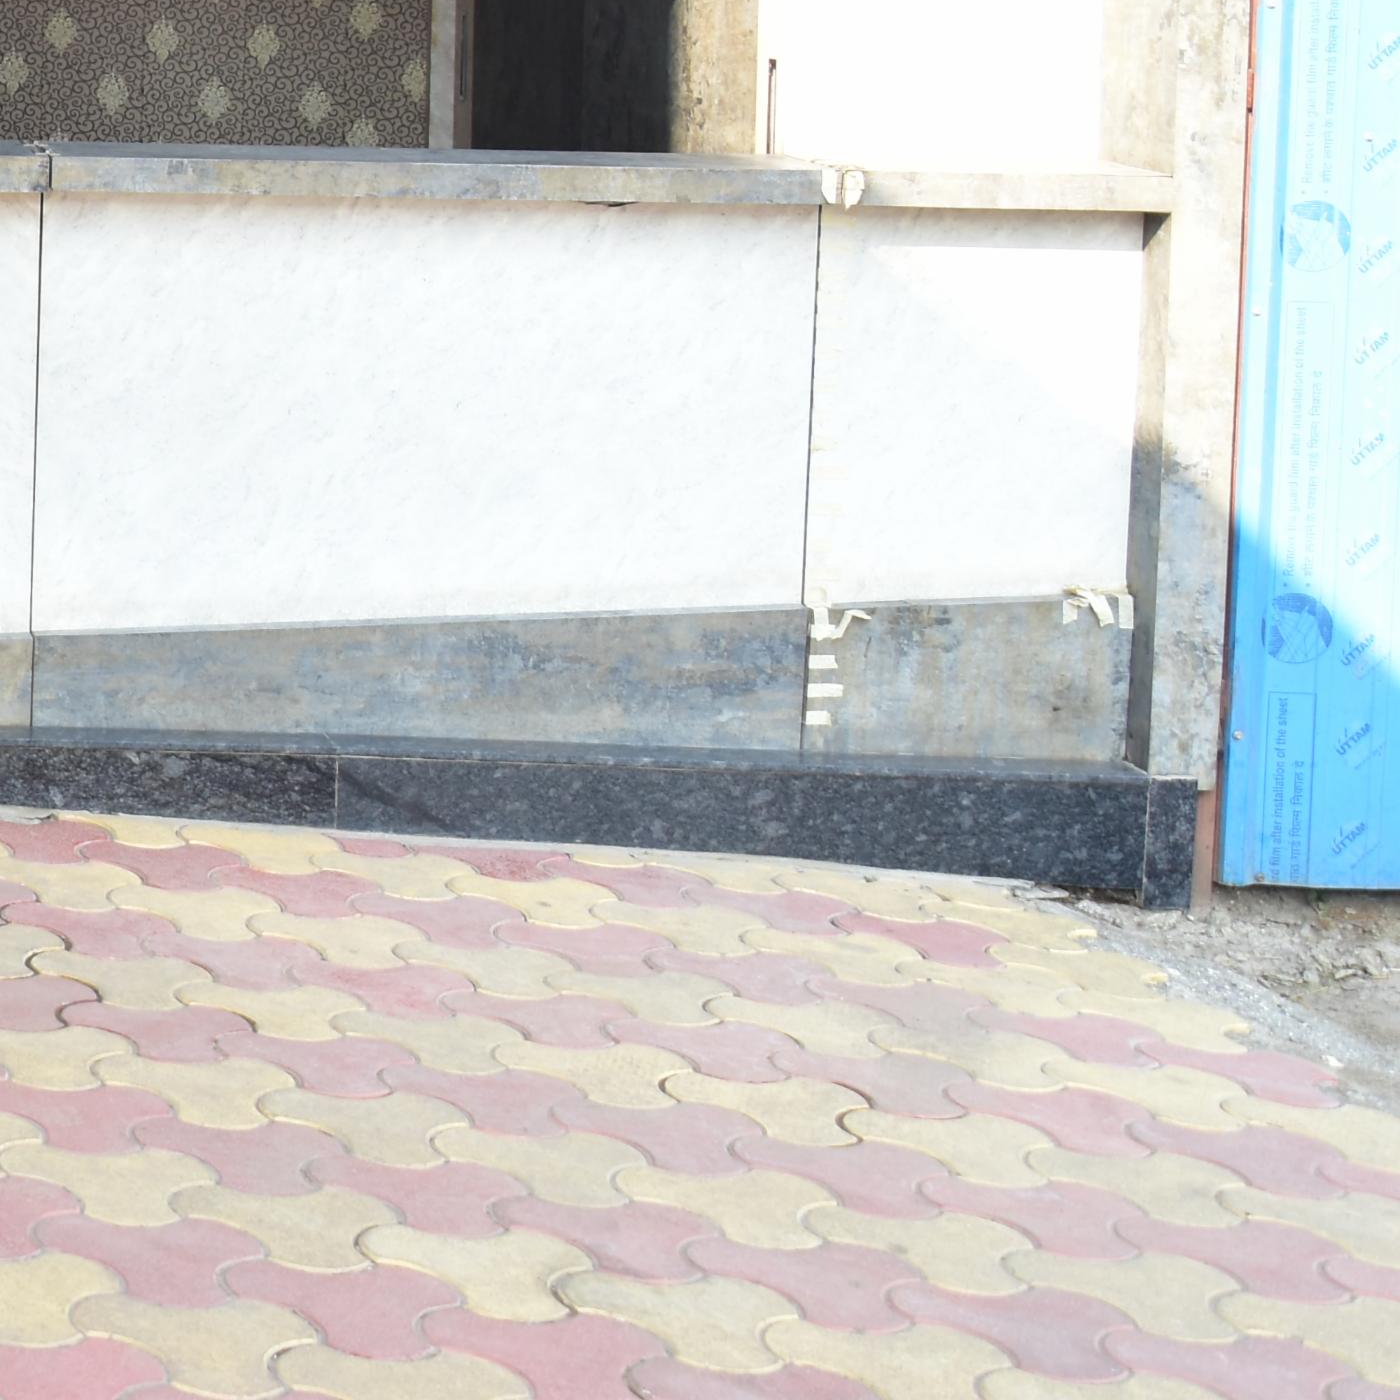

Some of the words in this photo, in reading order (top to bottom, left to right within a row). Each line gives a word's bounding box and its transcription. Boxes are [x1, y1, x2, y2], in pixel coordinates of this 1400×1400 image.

[1277, 696, 1289, 726] sheet
[1275, 729, 1287, 745] the
[1274, 747, 1287, 758] of
[1271, 761, 1287, 818] installation
[1271, 821, 1283, 844] after
